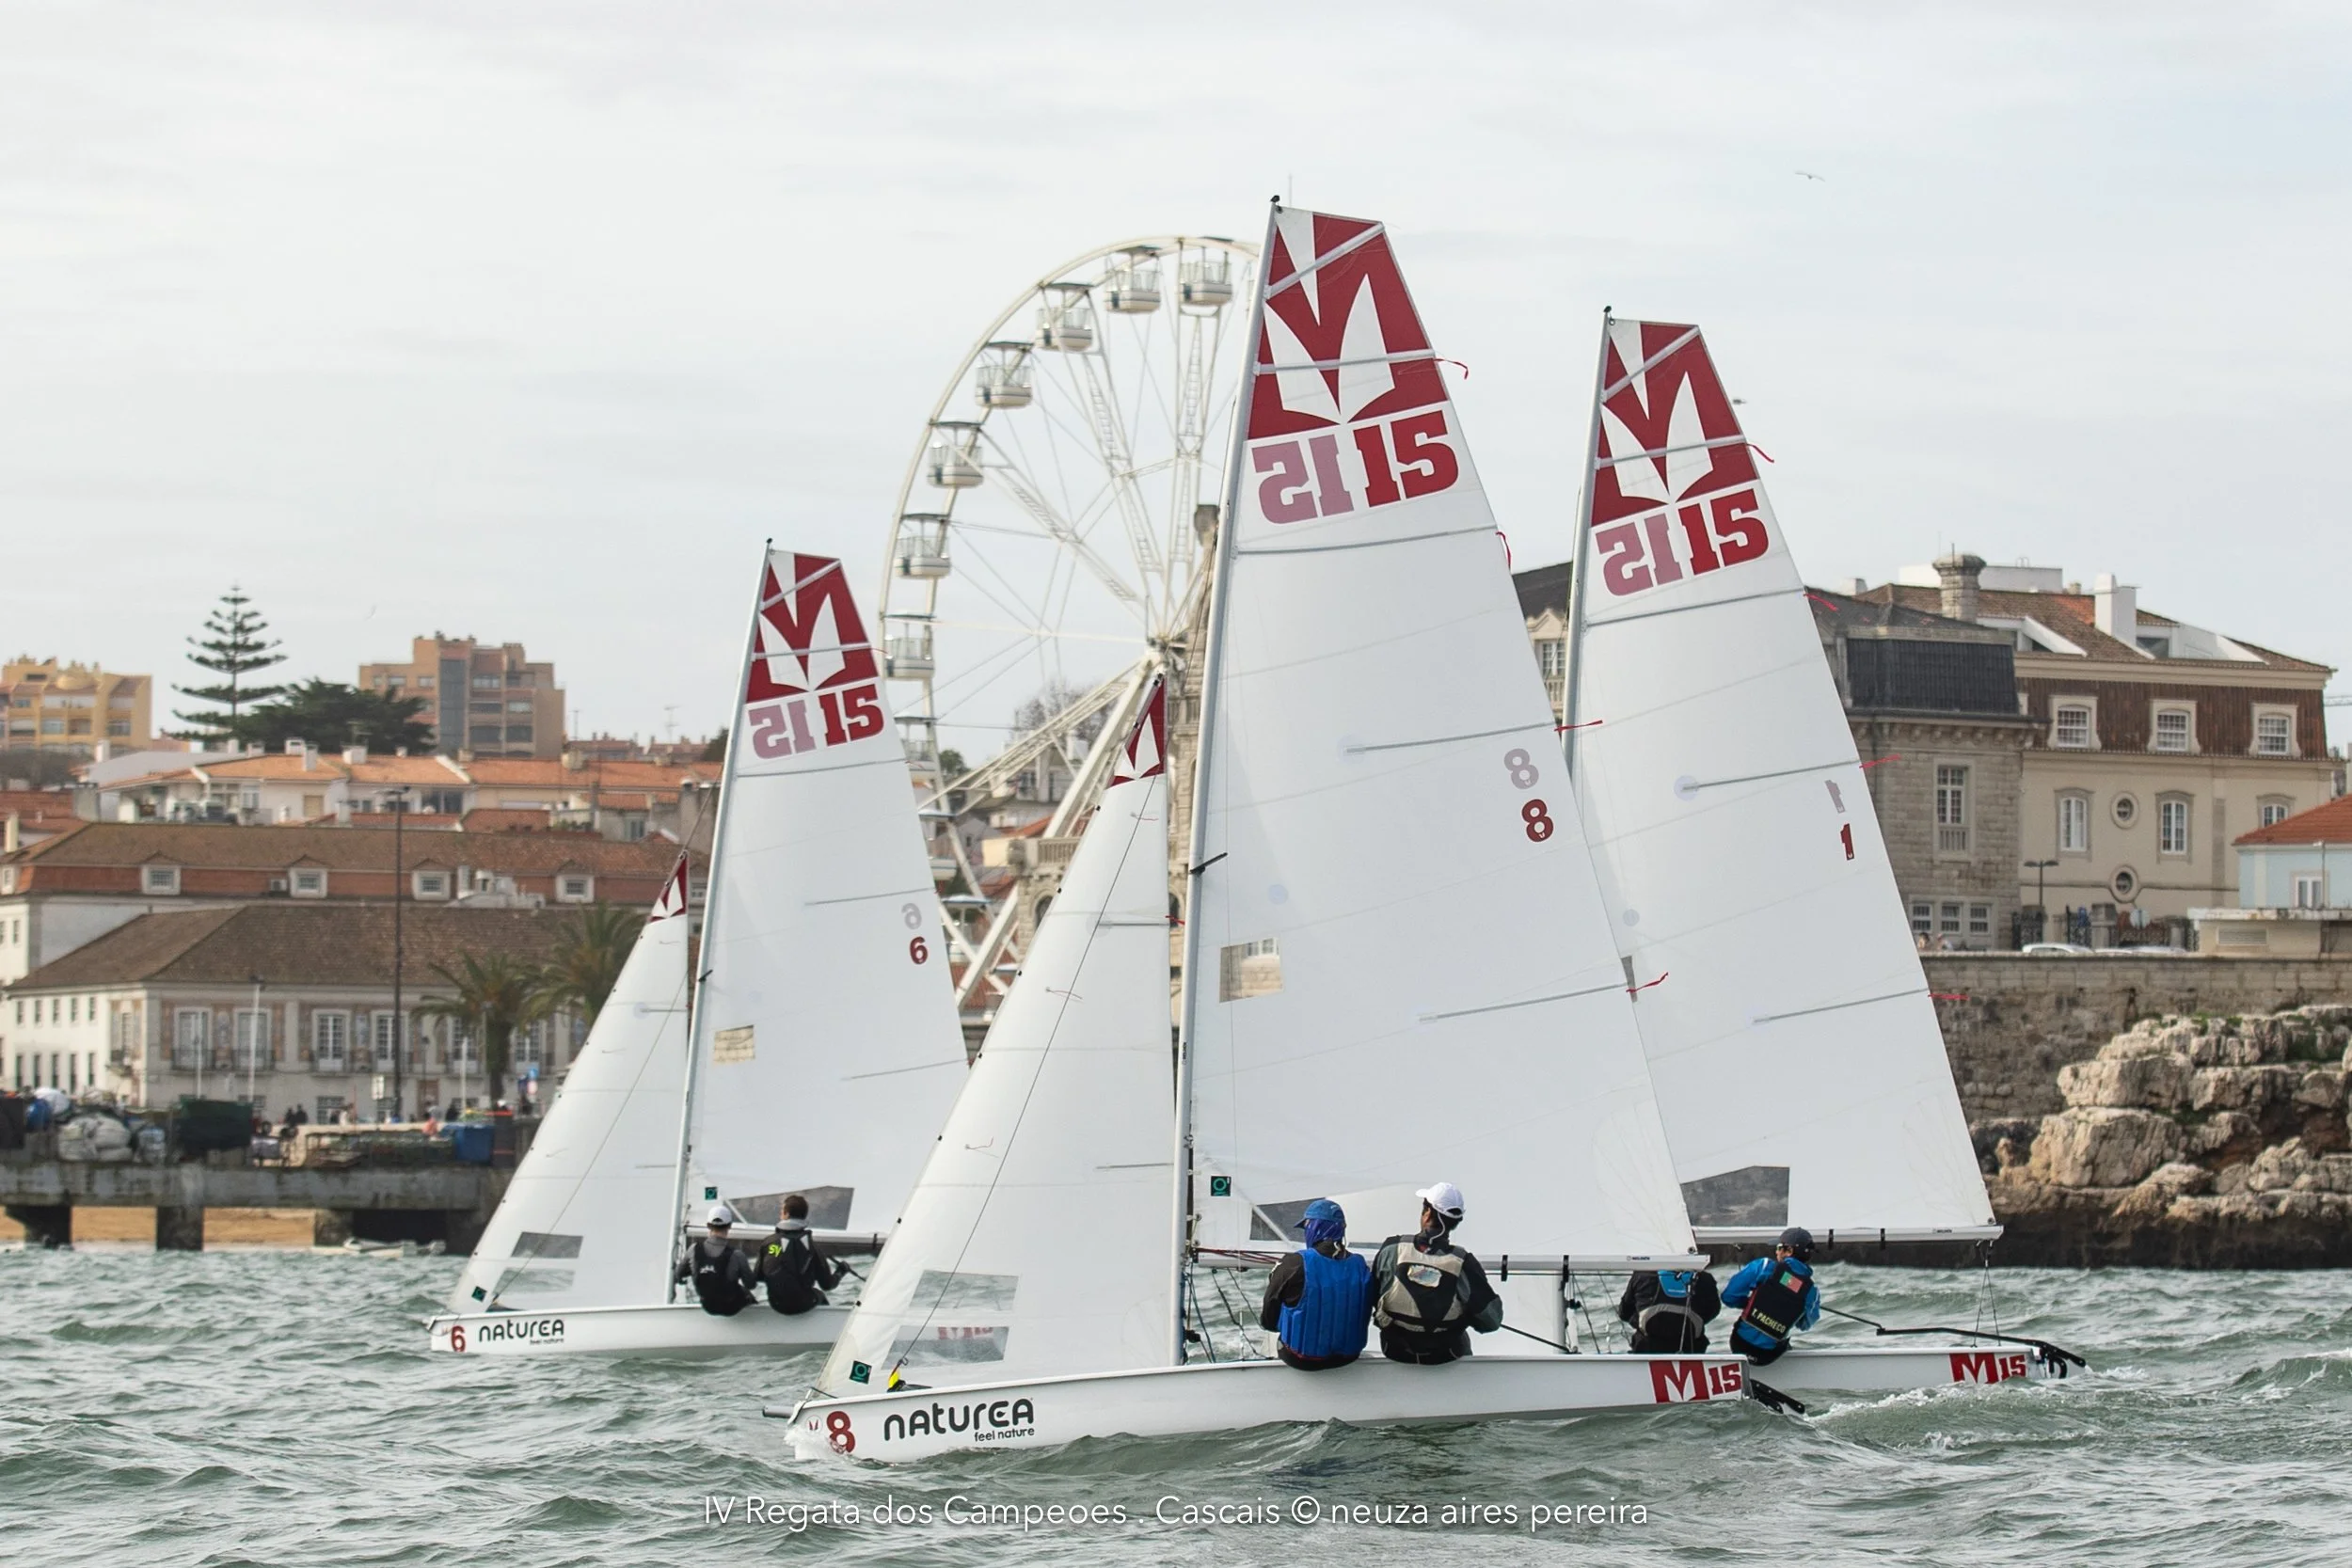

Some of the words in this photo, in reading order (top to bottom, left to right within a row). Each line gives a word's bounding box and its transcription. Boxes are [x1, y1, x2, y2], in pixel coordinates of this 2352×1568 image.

[1352, 410, 1459, 508] 15
[1677, 488, 1770, 576] 15
[818, 684, 884, 746] 15
[1521, 799, 1554, 843] 8
[1840, 823, 1854, 861] 1
[909, 936, 929, 965] 6
[451, 1324, 467, 1353] 6
[1756, 1312, 1788, 1334] PACHECO
[826, 1410, 856, 1455] 8
[974, 1431, 995, 1442] feel
[997, 1427, 1035, 1439] nature
